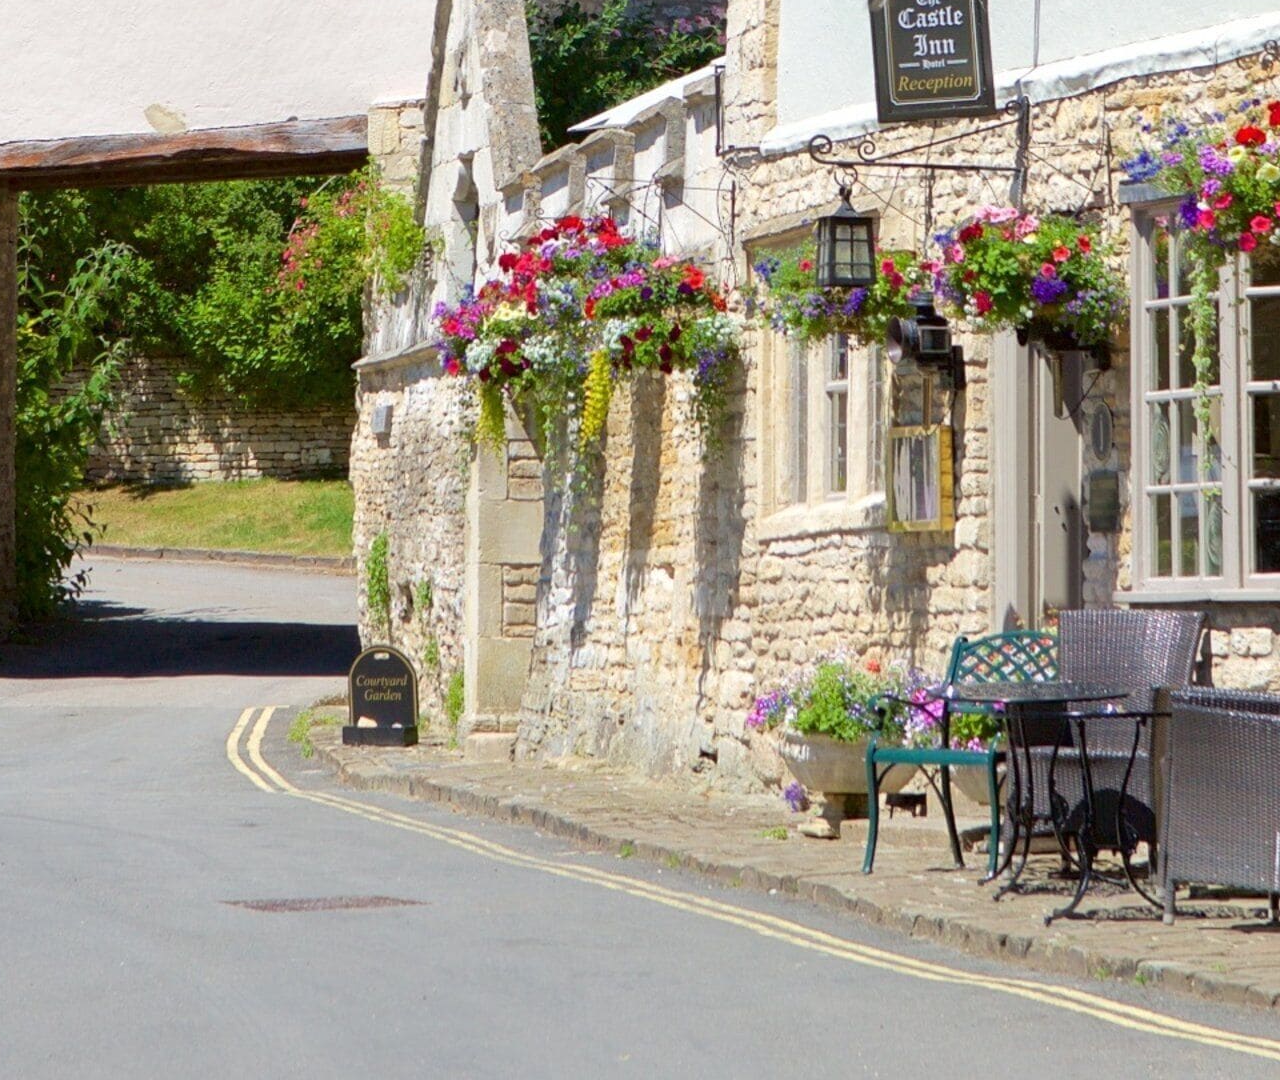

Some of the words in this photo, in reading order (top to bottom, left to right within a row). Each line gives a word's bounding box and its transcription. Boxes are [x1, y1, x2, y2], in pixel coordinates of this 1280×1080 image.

[898, 6, 964, 29] Castle
[913, 34, 956, 57] Inn
[922, 58, 946, 70] Hotel
[898, 74, 973, 93] Reception
[356, 674, 408, 689] Courtyard
[364, 689, 402, 701] Garden
